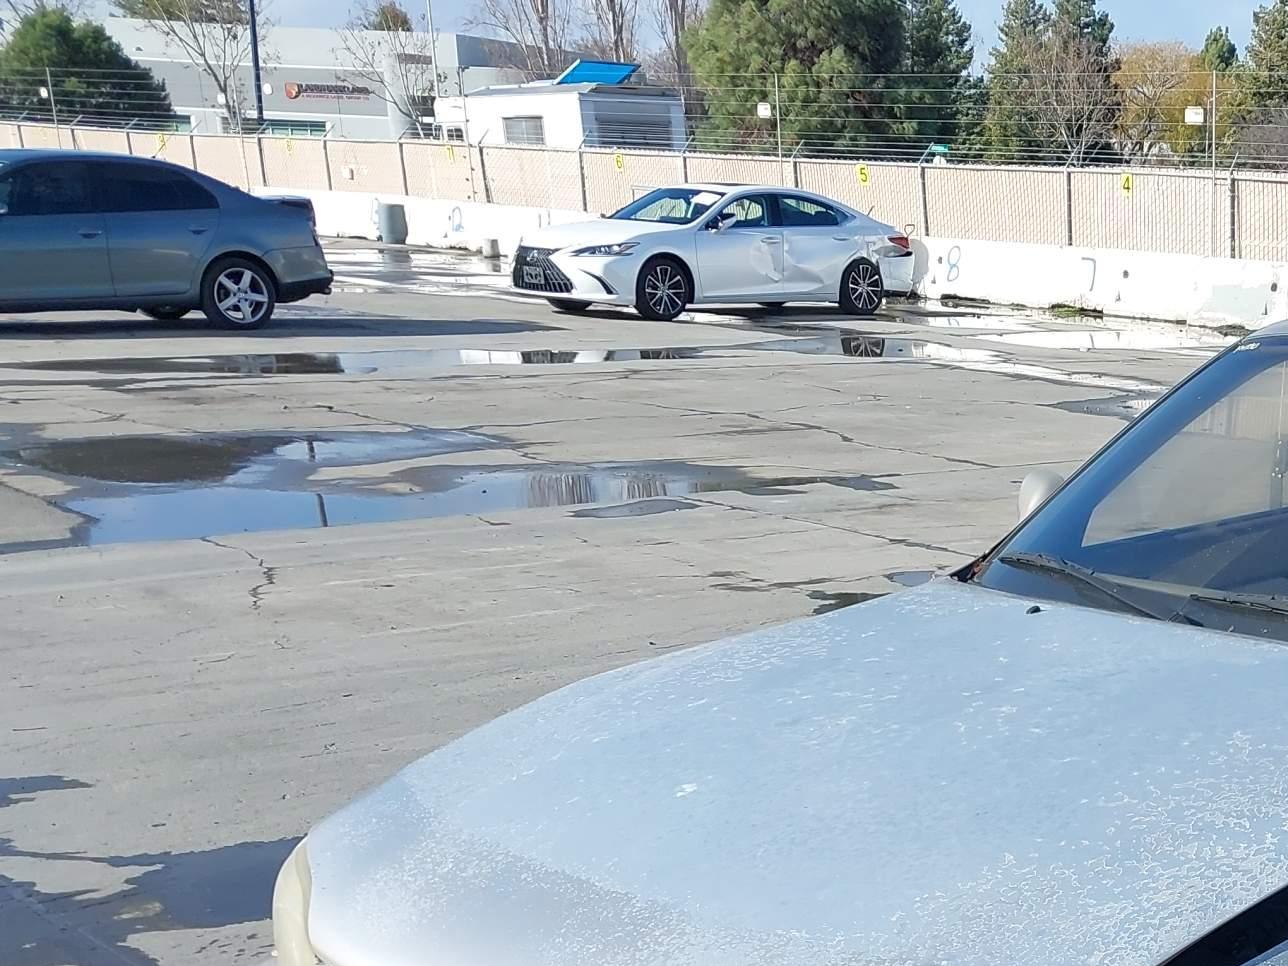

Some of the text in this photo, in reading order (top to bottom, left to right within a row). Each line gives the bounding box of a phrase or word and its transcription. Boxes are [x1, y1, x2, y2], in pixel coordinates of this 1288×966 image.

[615, 155, 623, 169] 6
[859, 167, 868, 183] 5
[1122, 175, 1131, 193] 4
[947, 245, 961, 282] 8
[1080, 256, 1097, 292] 7
